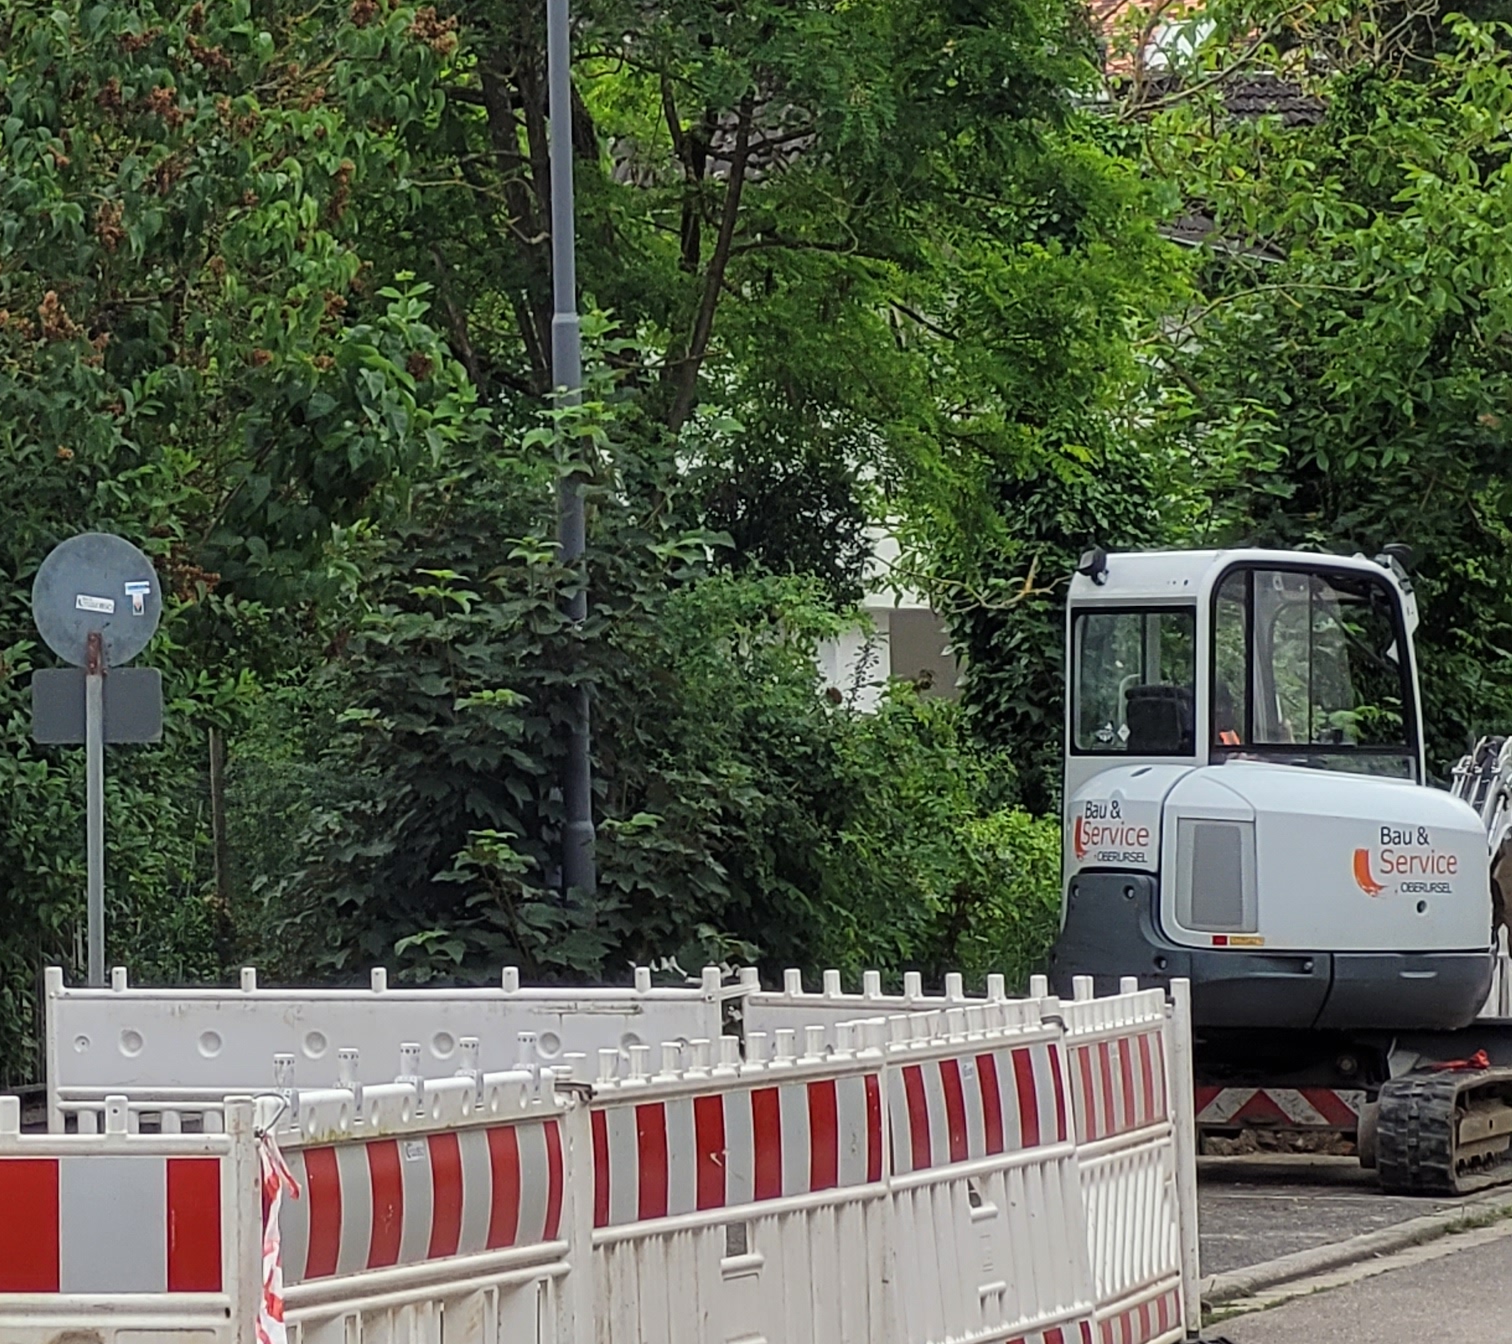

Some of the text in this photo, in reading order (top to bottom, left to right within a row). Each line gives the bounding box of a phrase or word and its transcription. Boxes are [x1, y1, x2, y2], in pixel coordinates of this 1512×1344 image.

[1085, 800, 1121, 819] Bau &
[1081, 821, 1149, 846] Service
[1380, 826, 1429, 845] Bau &
[1380, 849, 1457, 874] Service
